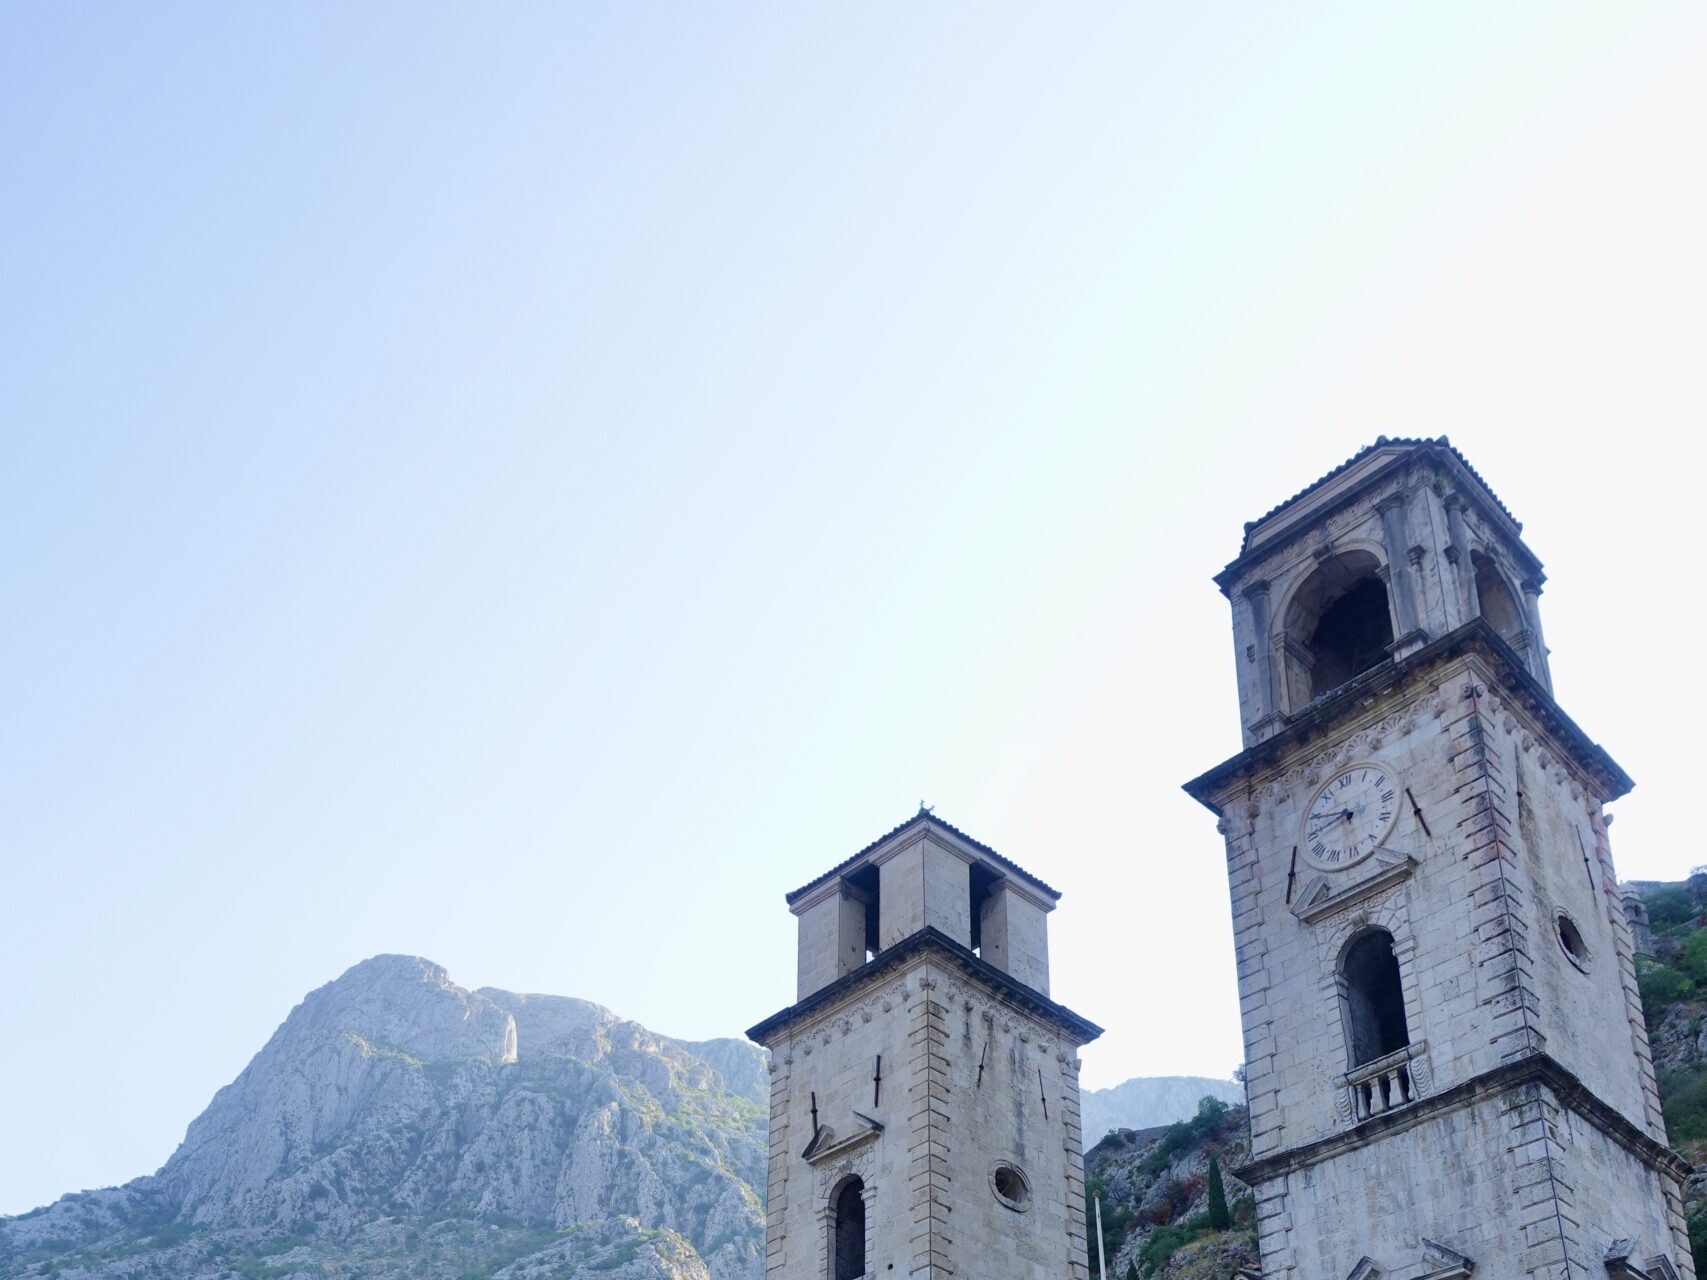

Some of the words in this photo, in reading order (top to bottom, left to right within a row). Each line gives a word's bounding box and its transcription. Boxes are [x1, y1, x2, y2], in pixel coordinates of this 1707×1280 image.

[1338, 774, 1352, 790] XII
[1374, 775, 1386, 788] II
[1320, 789, 1334, 803] XI
[1380, 789, 1394, 803] III
